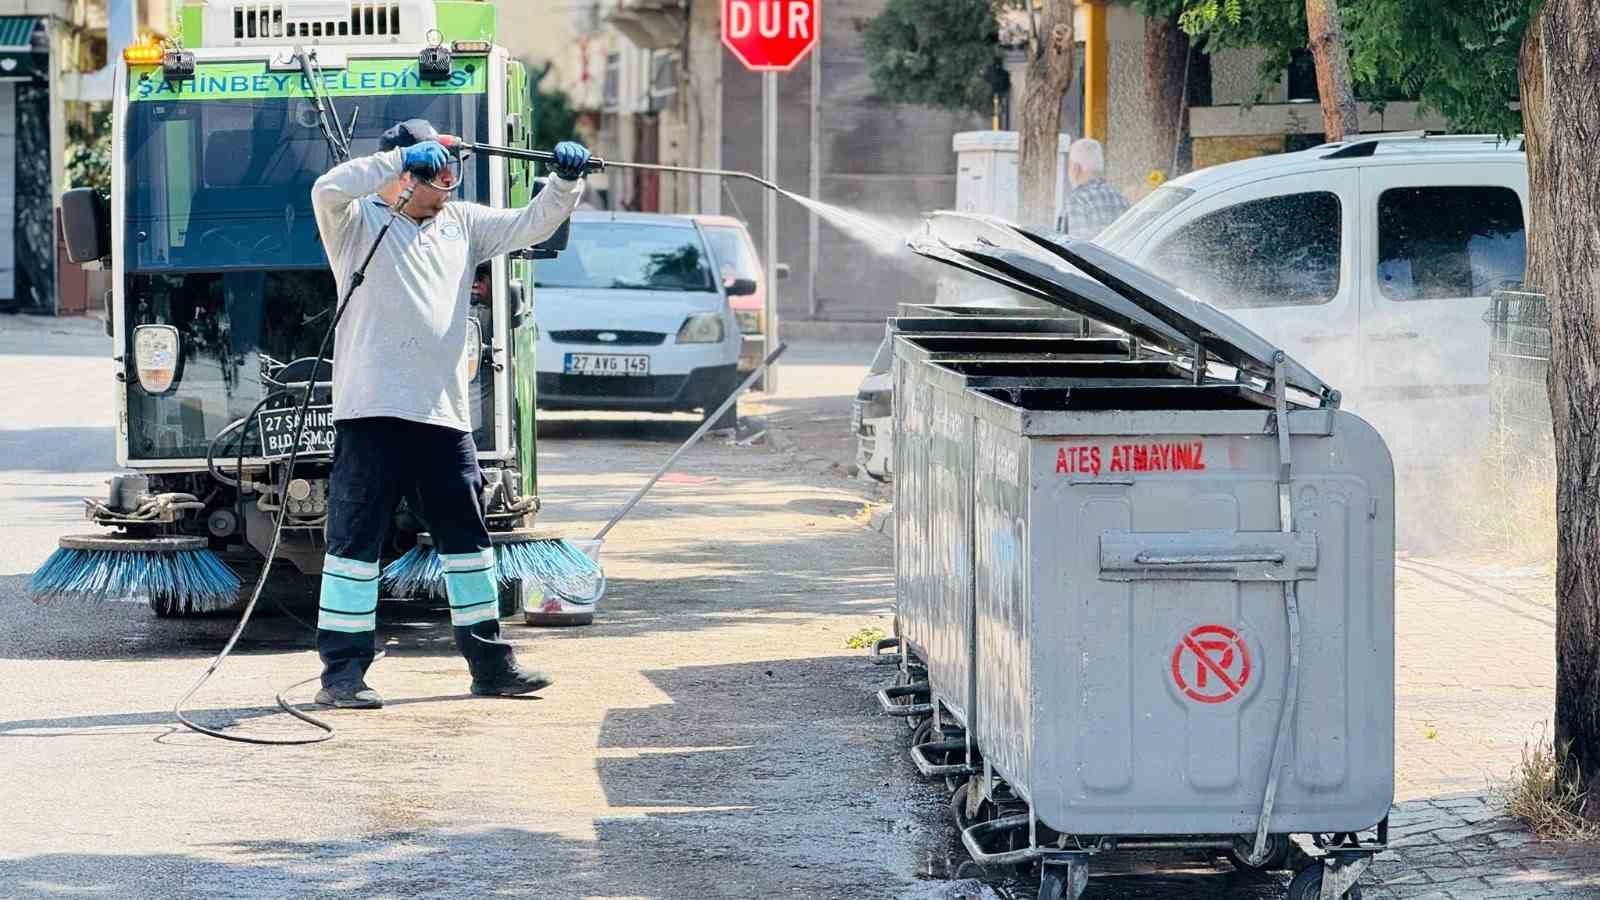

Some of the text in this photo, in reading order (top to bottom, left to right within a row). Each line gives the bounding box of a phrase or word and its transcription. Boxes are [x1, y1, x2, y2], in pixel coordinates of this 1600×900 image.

[730, 0, 809, 39] DUR
[138, 67, 475, 97] ŞAHİNBEY BELEDİYSİ
[574, 356, 646, 370] 27 AVG 145
[265, 417, 282, 431] 27
[1056, 446, 1101, 476] ATEŞ
[1110, 441, 1205, 472] ATMAYINIZ
